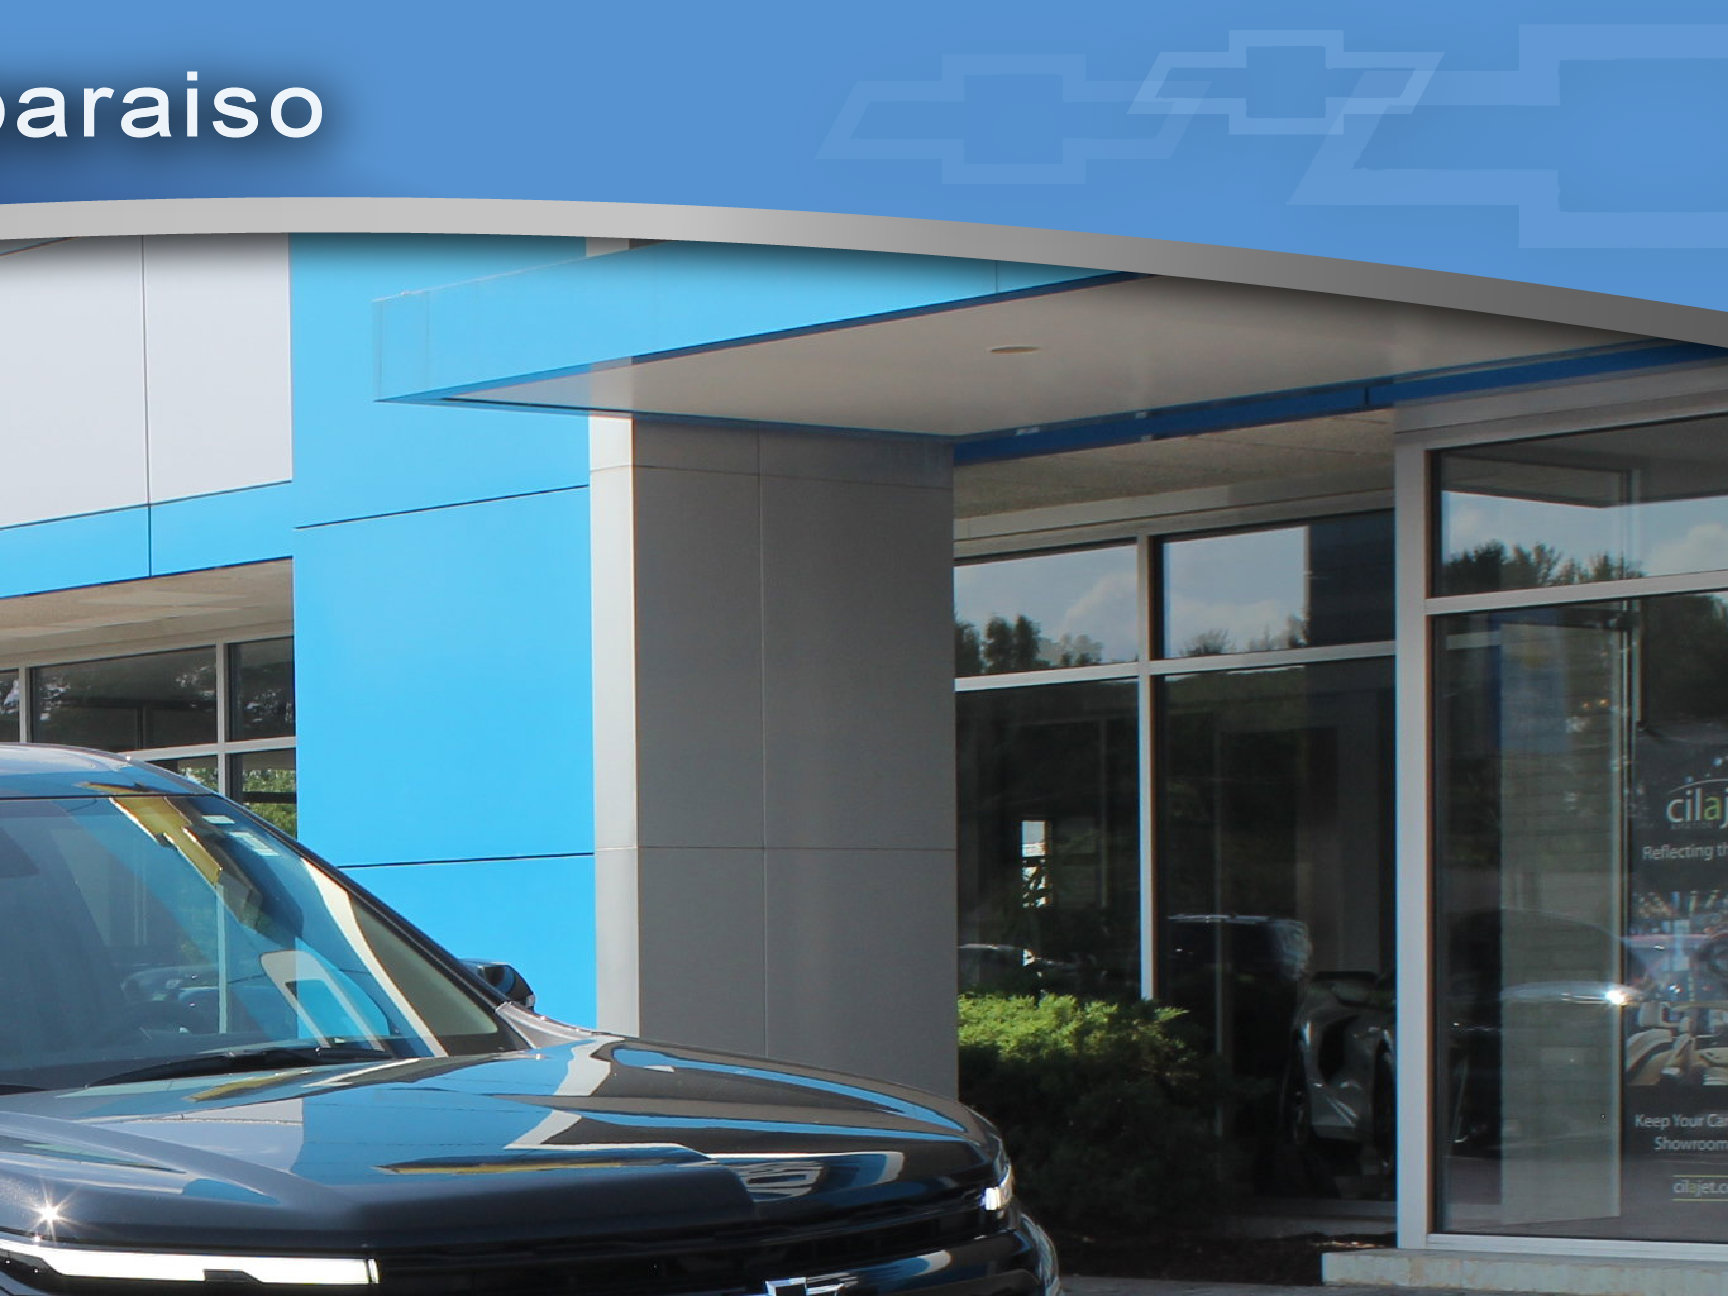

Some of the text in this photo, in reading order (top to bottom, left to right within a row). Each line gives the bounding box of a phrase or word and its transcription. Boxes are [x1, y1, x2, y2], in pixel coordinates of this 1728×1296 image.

[1642, 843, 1714, 862] Reflecting
[1635, 1113, 1671, 1130] Keep
[1672, 1113, 1704, 1128] Your
